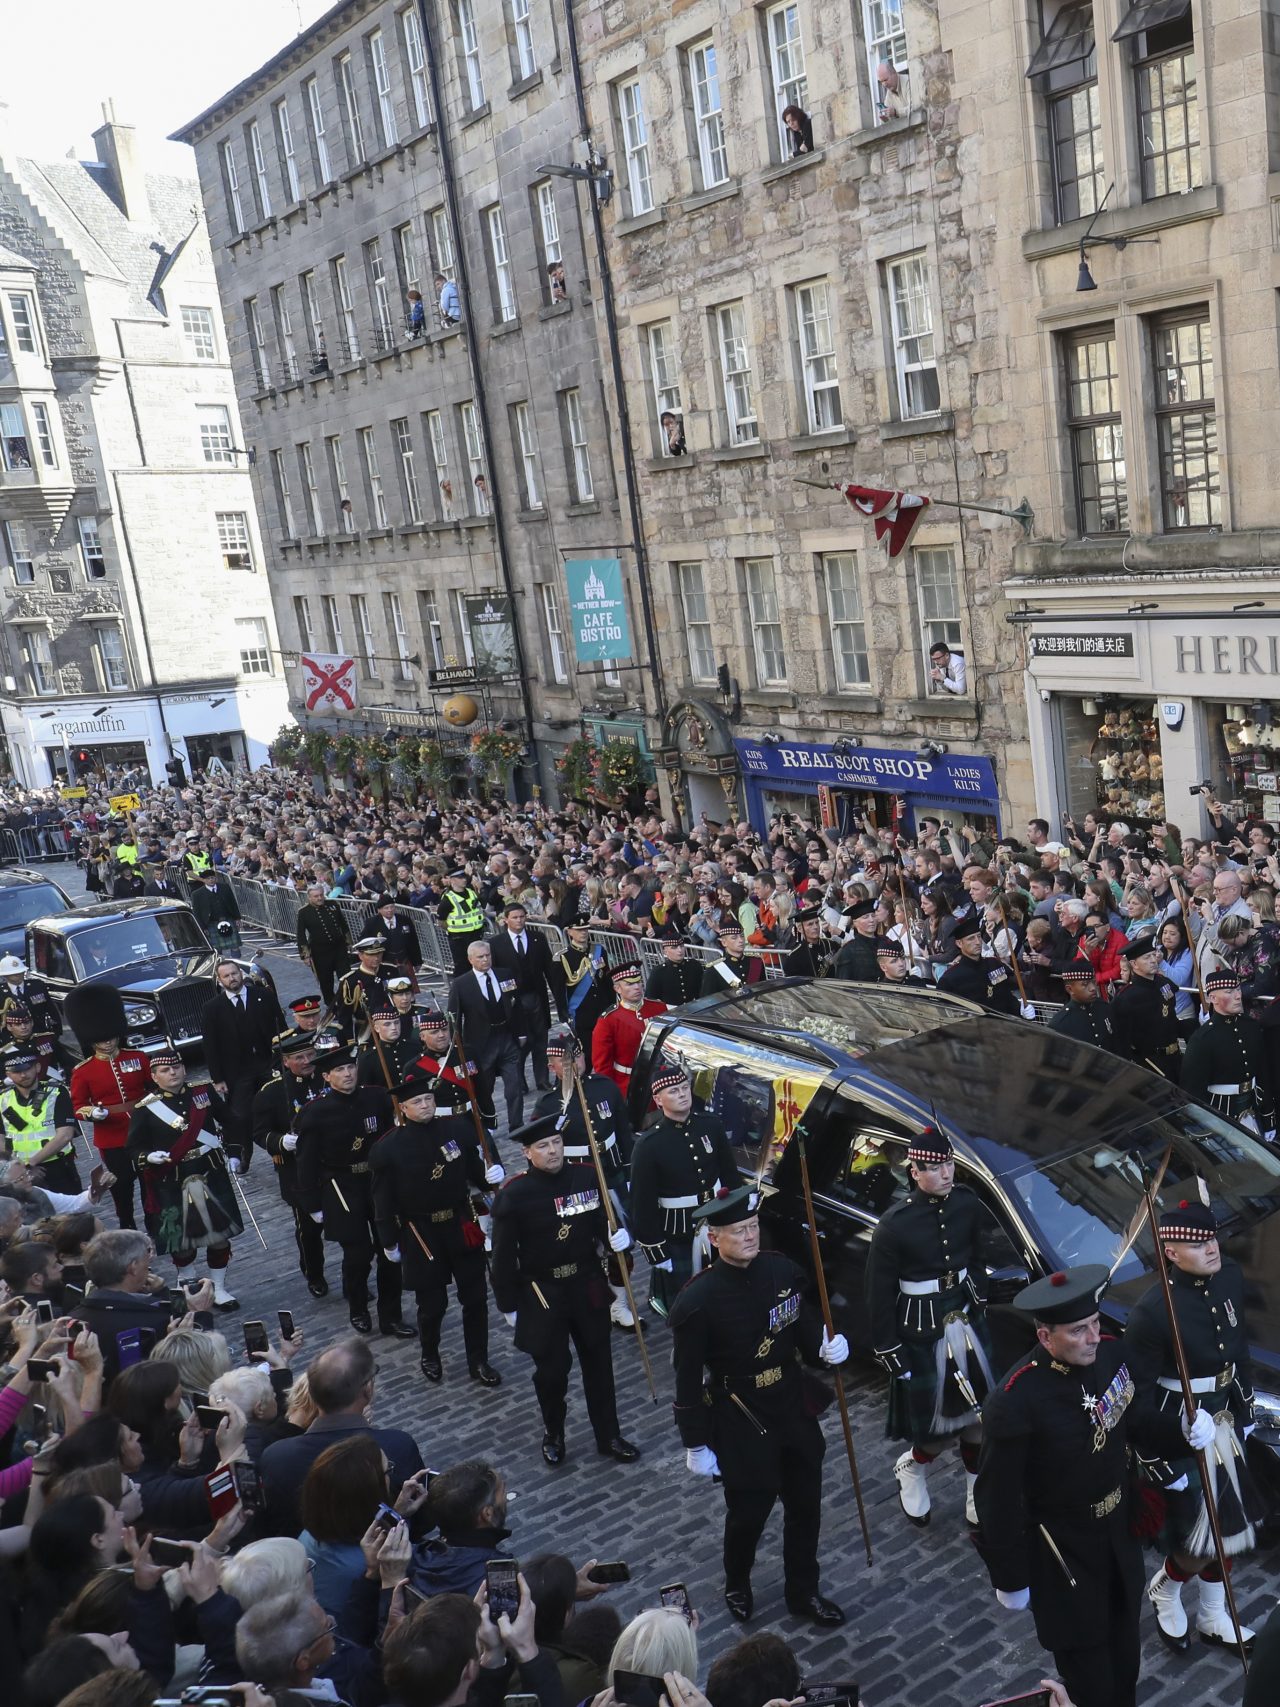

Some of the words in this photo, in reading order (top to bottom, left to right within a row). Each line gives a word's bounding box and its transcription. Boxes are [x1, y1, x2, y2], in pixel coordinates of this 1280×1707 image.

[577, 601, 600, 610] NETHER
[600, 600, 615, 608] BOW
[583, 612, 614, 628] CAFE
[580, 626, 622, 643] BISTRO
[1038, 636, 1125, 653] 欢迎到我们的通关店
[436, 669, 475, 681] BELHAVEN
[381, 712, 394, 722] THE
[395, 713, 424, 726] WORLD'S
[51, 715, 125, 738] ragamuffin
[745, 750, 763, 760] KIDS
[748, 760, 769, 771] KILTS
[778, 749, 834, 768] REAL
[835, 755, 870, 772] SCOT
[873, 757, 933, 780] SHOP
[837, 771, 879, 785] CASHMERE
[947, 766, 981, 779] LADIES
[954, 779, 981, 791] KILTS
